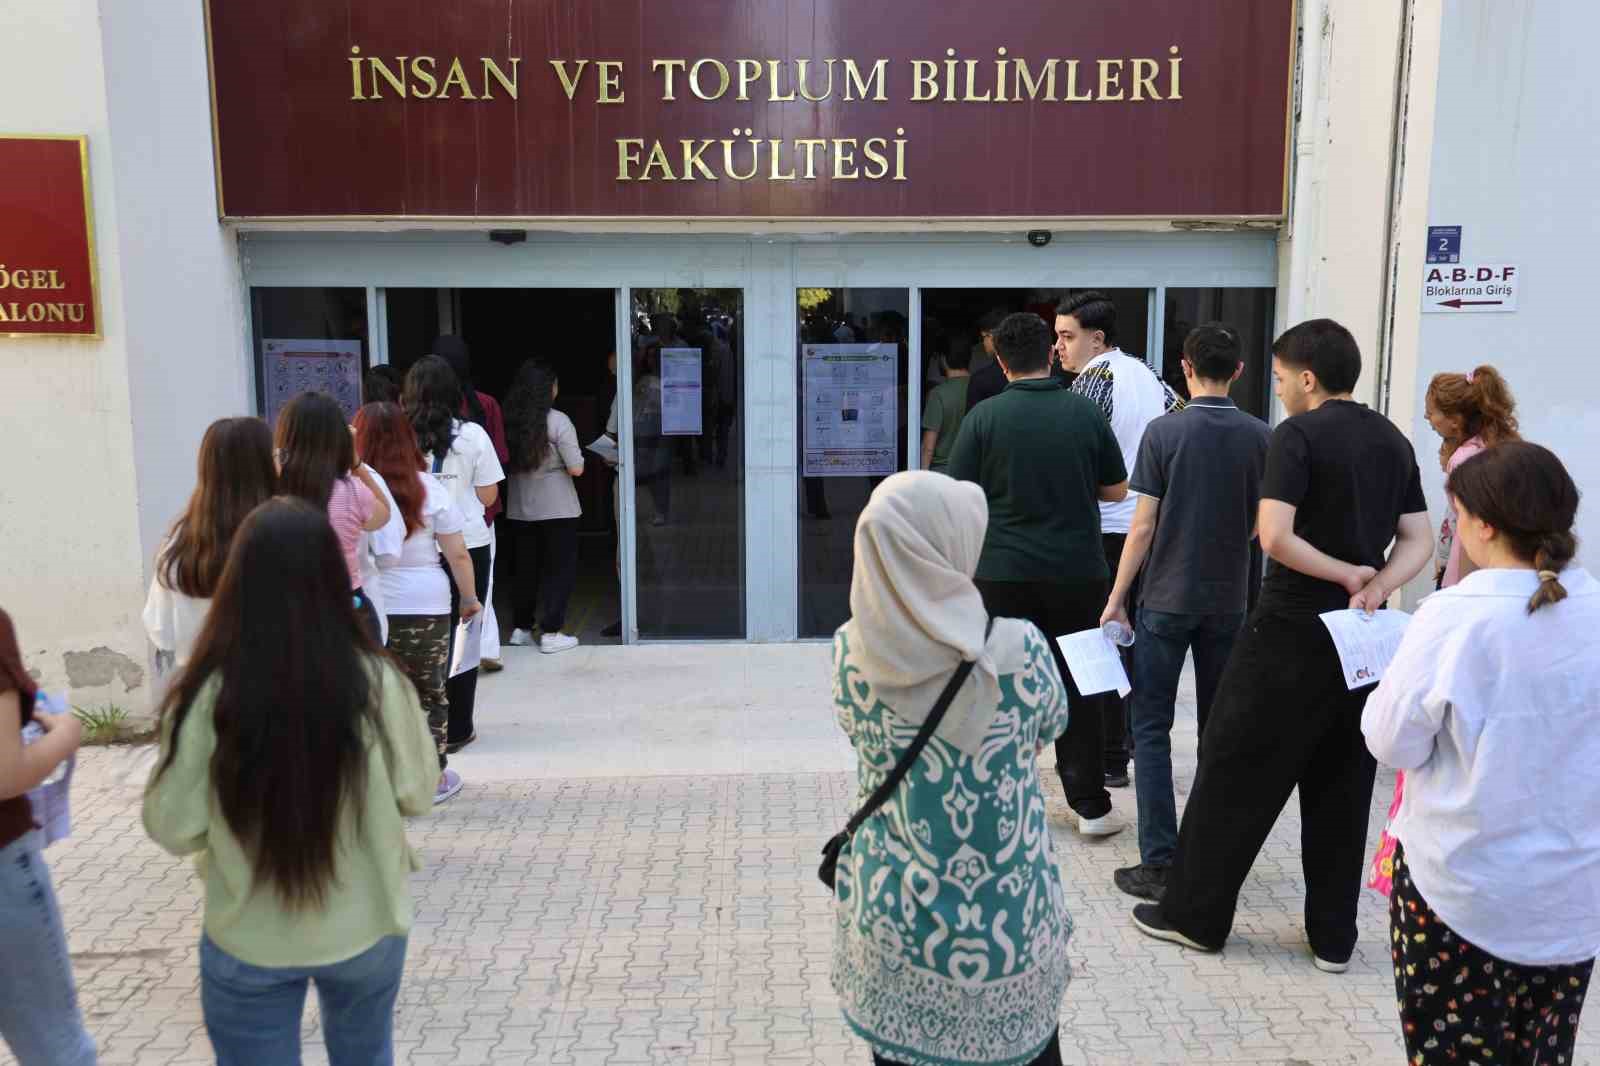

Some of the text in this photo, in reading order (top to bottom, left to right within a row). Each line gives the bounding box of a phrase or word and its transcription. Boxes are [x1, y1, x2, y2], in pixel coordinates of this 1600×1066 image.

[347, 45, 1183, 103] İNSAN VE TOPLUM BİLİMLERİ
[615, 127, 909, 181] FAKÜLTESİ
[1438, 238, 1449, 251] 2
[1426, 267, 1516, 283] A-B-D-F
[1426, 285, 1512, 297] Bloklarına Giriş
